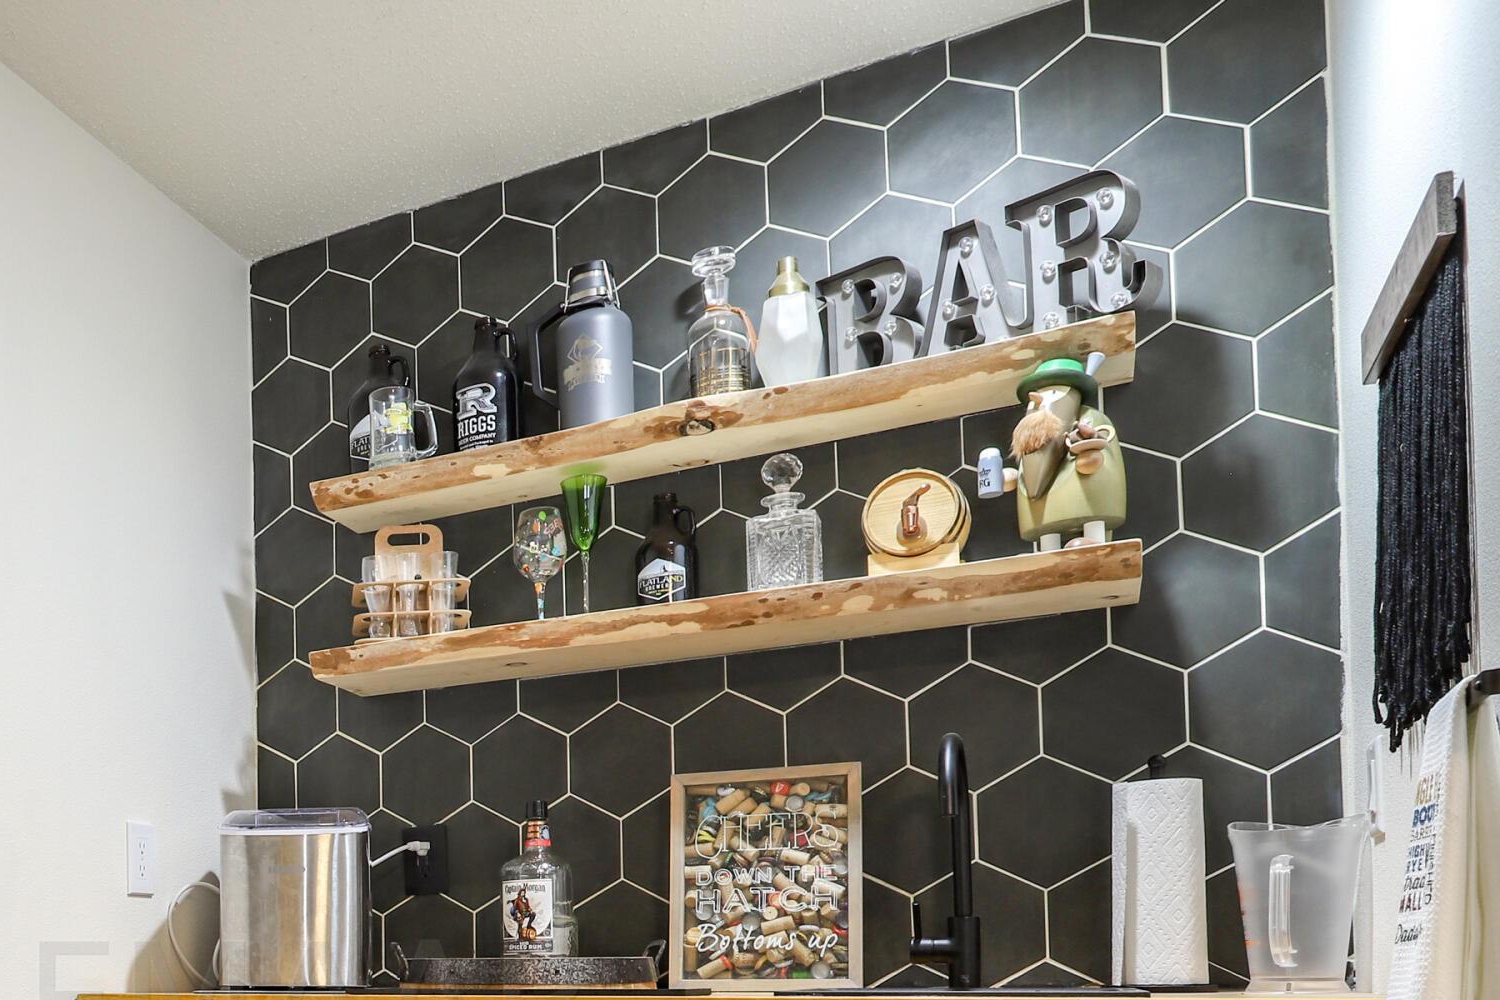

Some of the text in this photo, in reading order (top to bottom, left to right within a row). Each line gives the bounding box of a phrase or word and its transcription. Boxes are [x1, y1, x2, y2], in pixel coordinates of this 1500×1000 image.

[816, 169, 1163, 377] BAR
[457, 415, 496, 438] RIGGS
[469, 432, 497, 442] COMPANY
[639, 575, 683, 588] FLATLAND
[695, 808, 839, 859] CHEERS
[695, 864, 838, 886] DOWN THE
[695, 884, 838, 913] HATCH
[696, 923, 839, 957] Bottoms up
